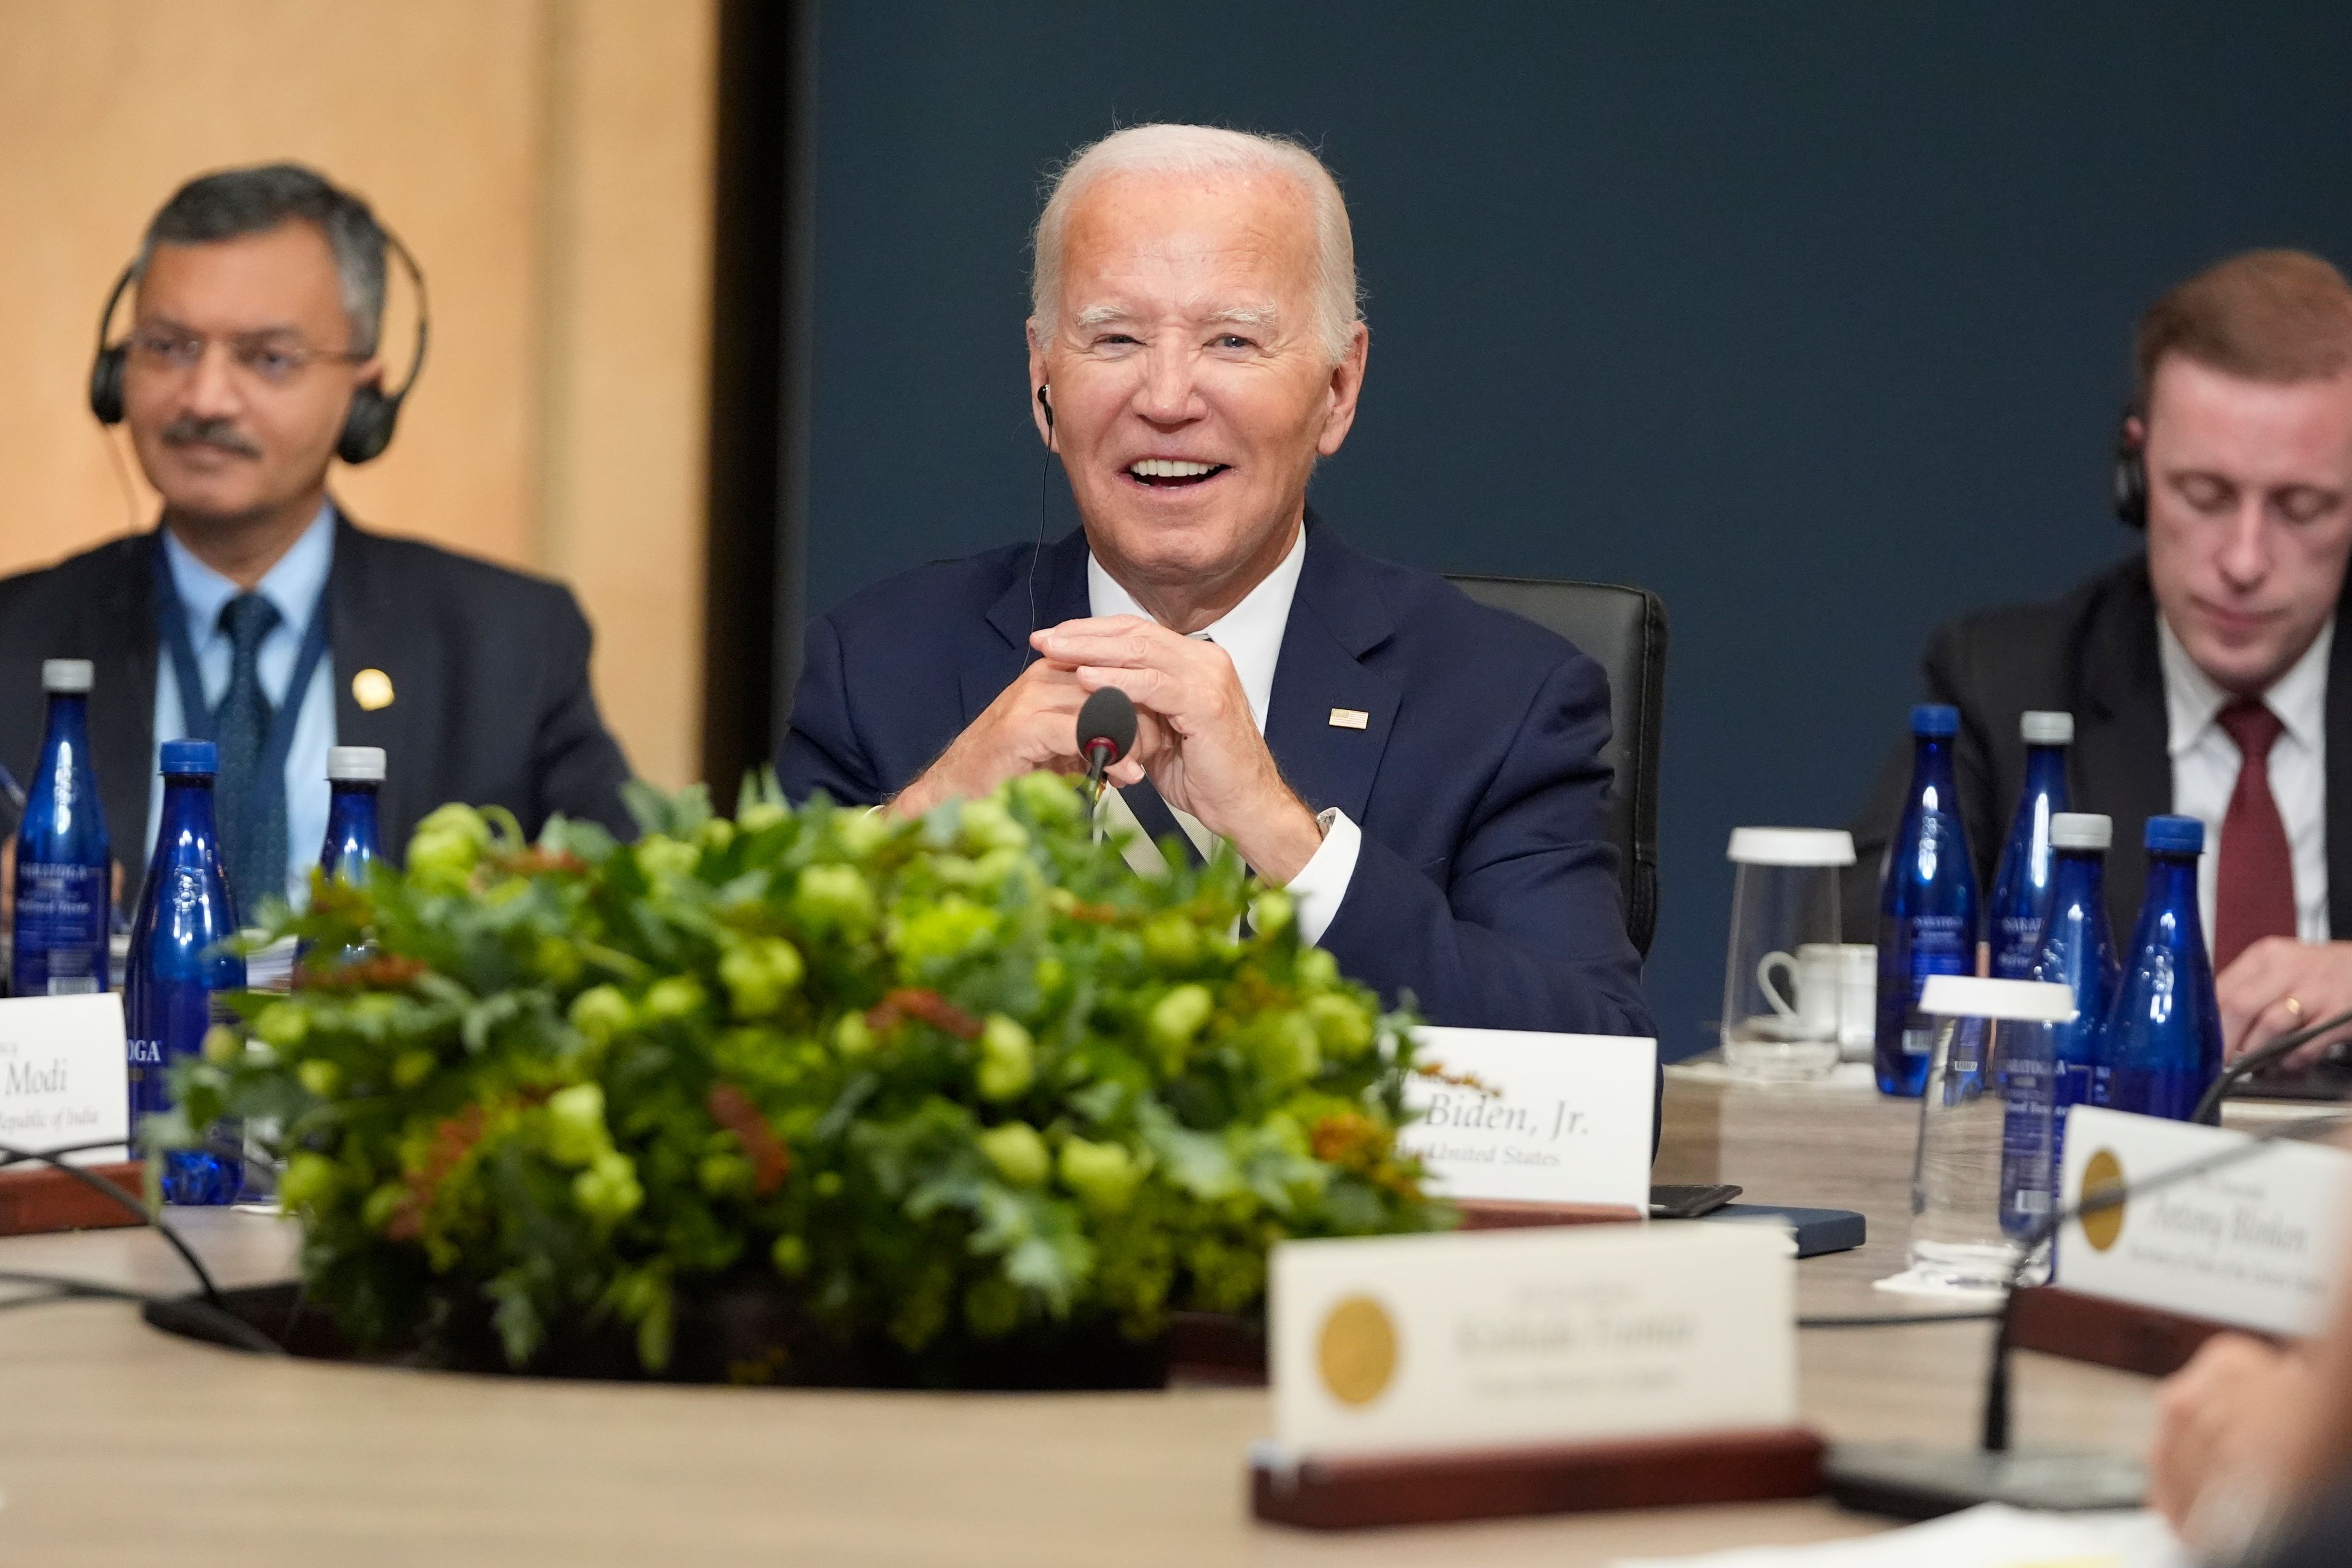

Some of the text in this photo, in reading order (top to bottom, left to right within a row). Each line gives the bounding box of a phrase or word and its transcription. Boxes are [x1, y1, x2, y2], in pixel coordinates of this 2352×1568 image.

[6, 1058, 68, 1095] Modi
[1425, 1093, 1588, 1142] Biden, Jr.
[1428, 1140, 1498, 1163] United
[1502, 1143, 1561, 1166] States
